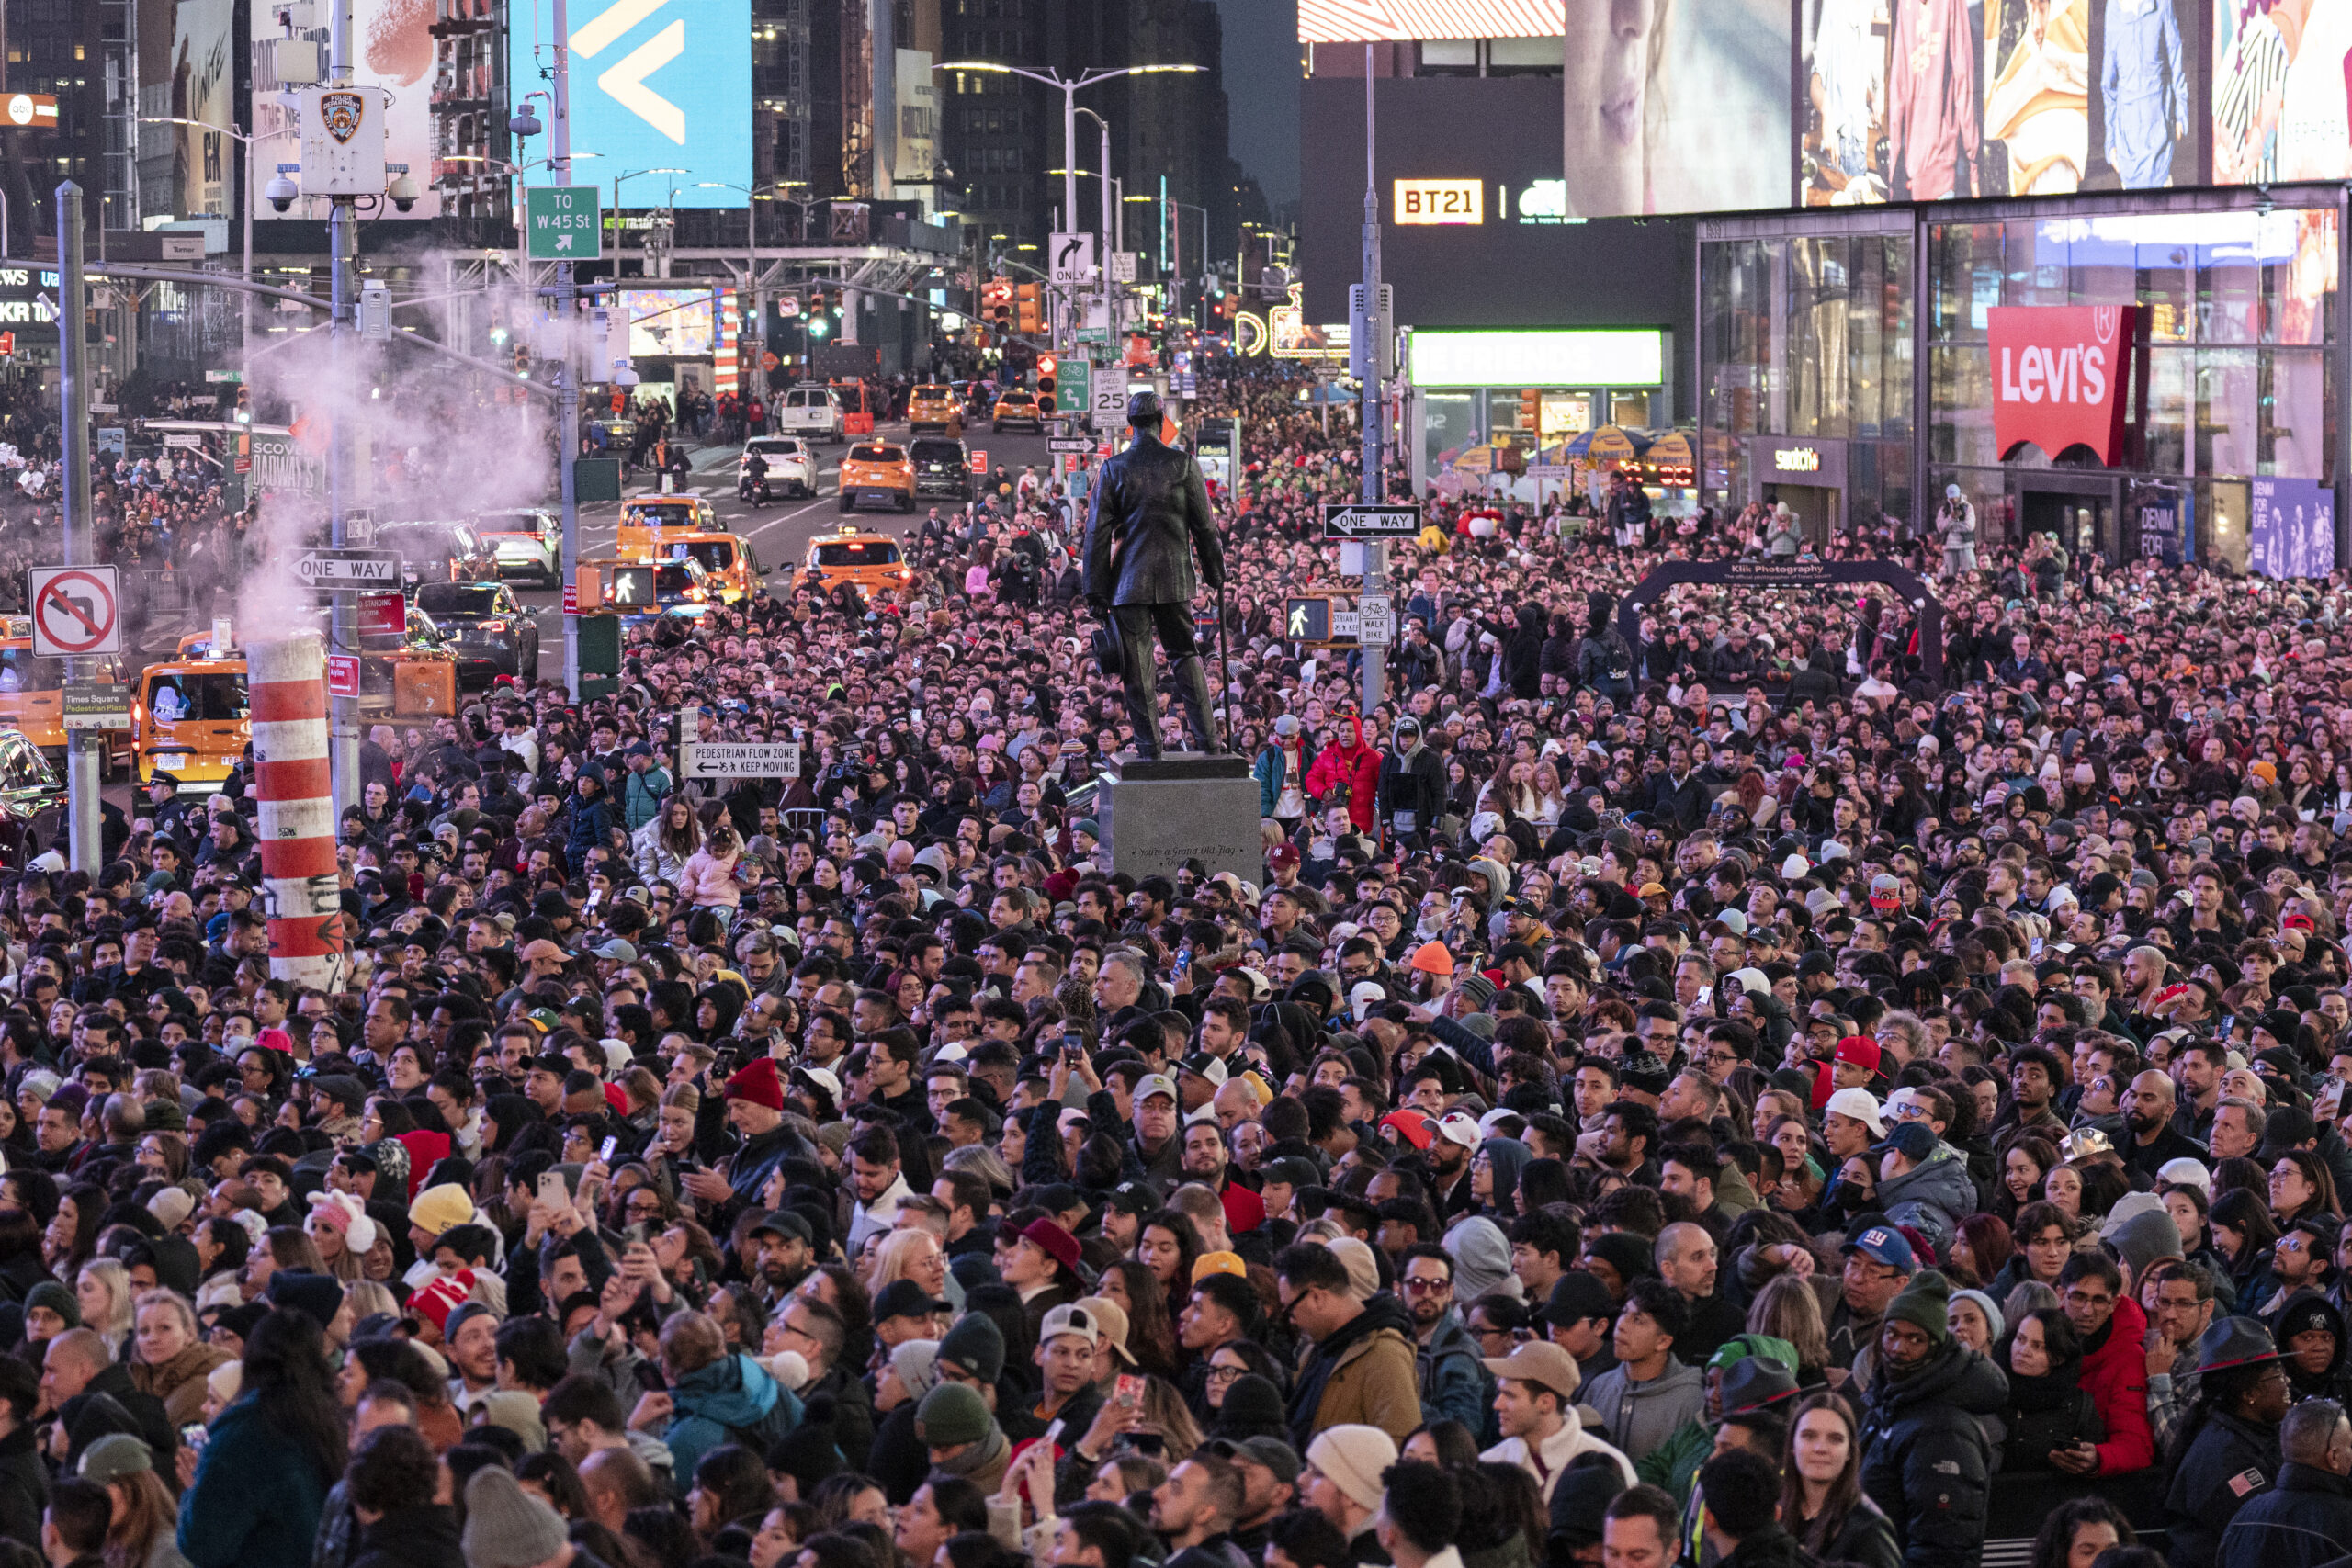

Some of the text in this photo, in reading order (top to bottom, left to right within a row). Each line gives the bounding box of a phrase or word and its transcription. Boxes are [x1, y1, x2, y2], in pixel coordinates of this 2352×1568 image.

[12, 105, 30, 113] abc
[323, 99, 360, 109] DEPARTMENT
[277, 164, 300, 173] NYPD
[387, 164, 409, 173] NYPD
[553, 195, 572, 209] TO
[1406, 190, 1472, 213] BT21
[537, 214, 590, 229] W 45 St
[1057, 271, 1086, 281] ONLY
[1102, 349, 1112, 358] 45
[1098, 393, 1124, 409] 25
[2254, 498, 2267, 513] FOR
[1340, 515, 1408, 527] ONE WAY
[2141, 508, 2174, 531] DENIM
[2141, 534, 2163, 556] FOR
[301, 560, 386, 578] ONE WAY
[1731, 564, 1824, 575] Klik Photography
[365, 599, 392, 608] STANDING
[1366, 631, 1383, 639] BIKE
[335, 659, 353, 669] STANDING
[91, 695, 119, 704] Square
[65, 705, 106, 713] Pedestrian
[695, 748, 795, 759] PEDESTRIAN FLOW ZONE
[740, 761, 795, 773] KEEP MOVING
